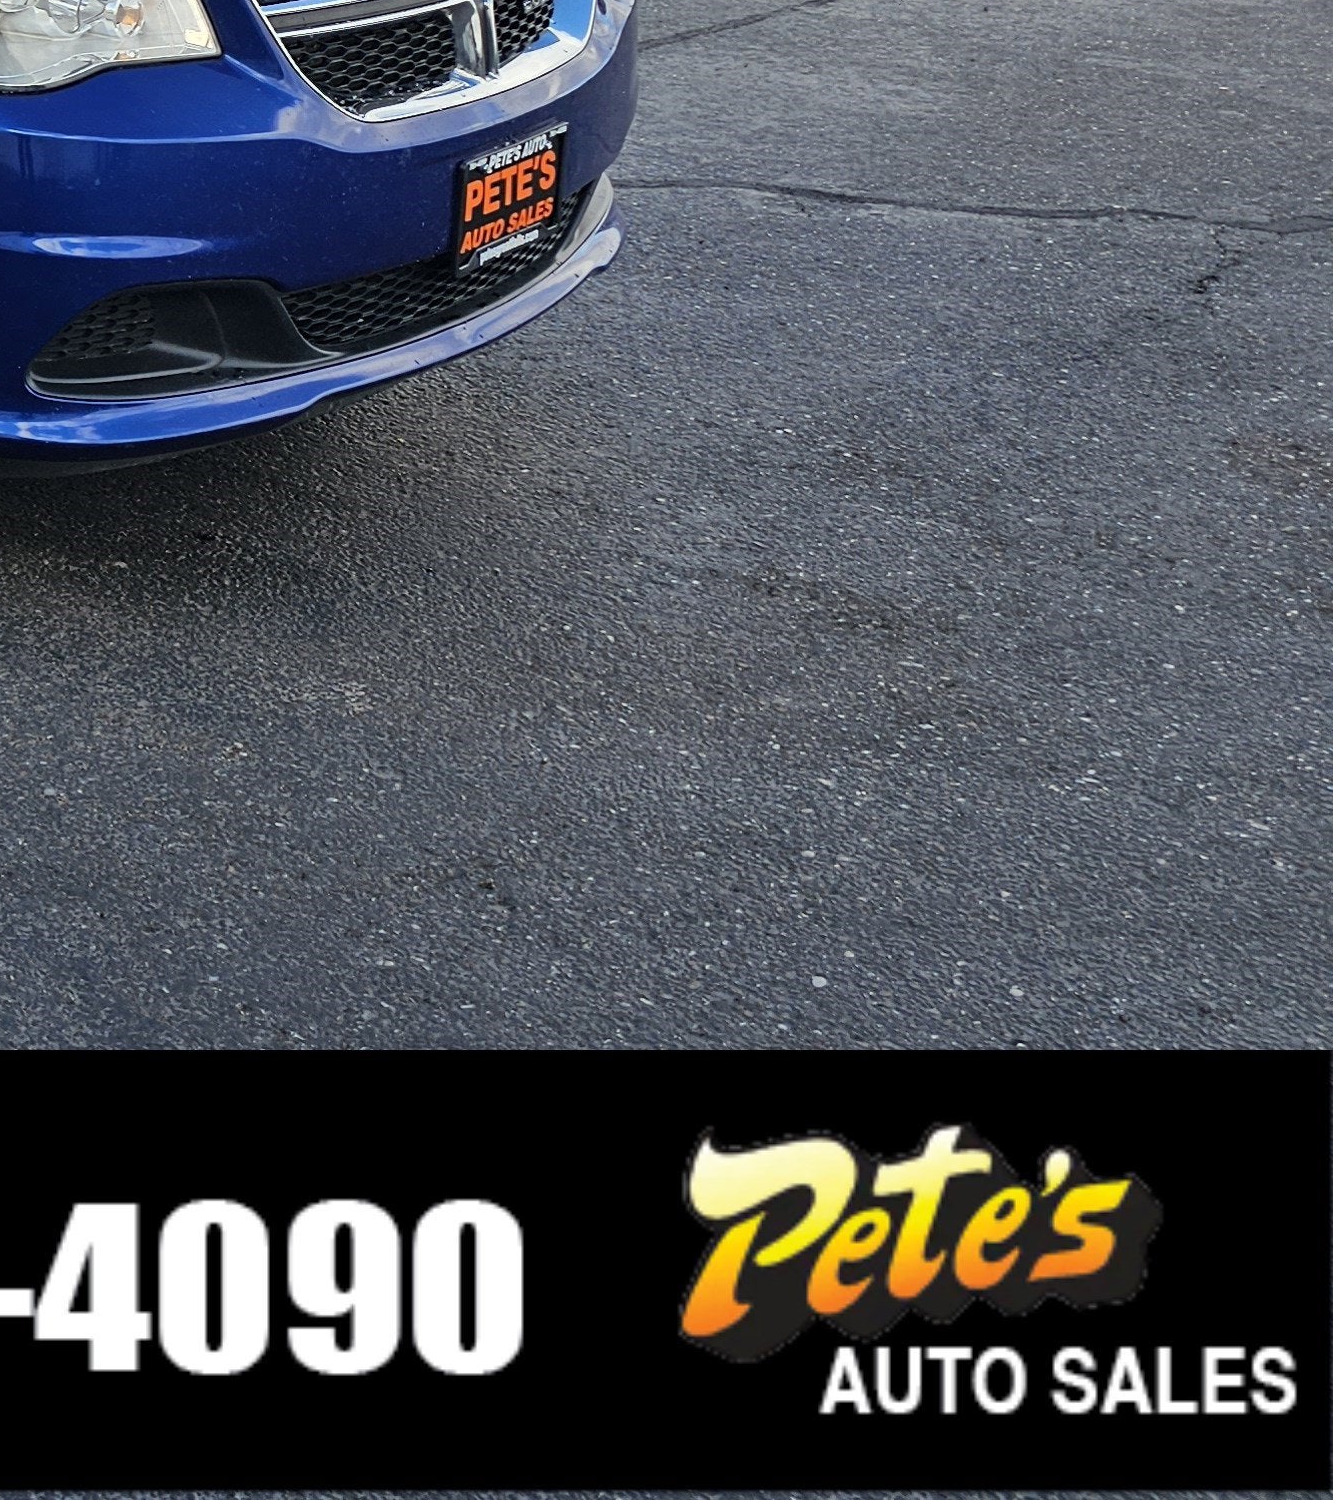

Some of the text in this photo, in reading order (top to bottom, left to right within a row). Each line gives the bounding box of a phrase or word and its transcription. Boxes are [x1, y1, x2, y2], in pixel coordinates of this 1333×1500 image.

[464, 149, 557, 223] PETE'S
[460, 217, 506, 255] AUTO
[506, 196, 555, 234] SALES
